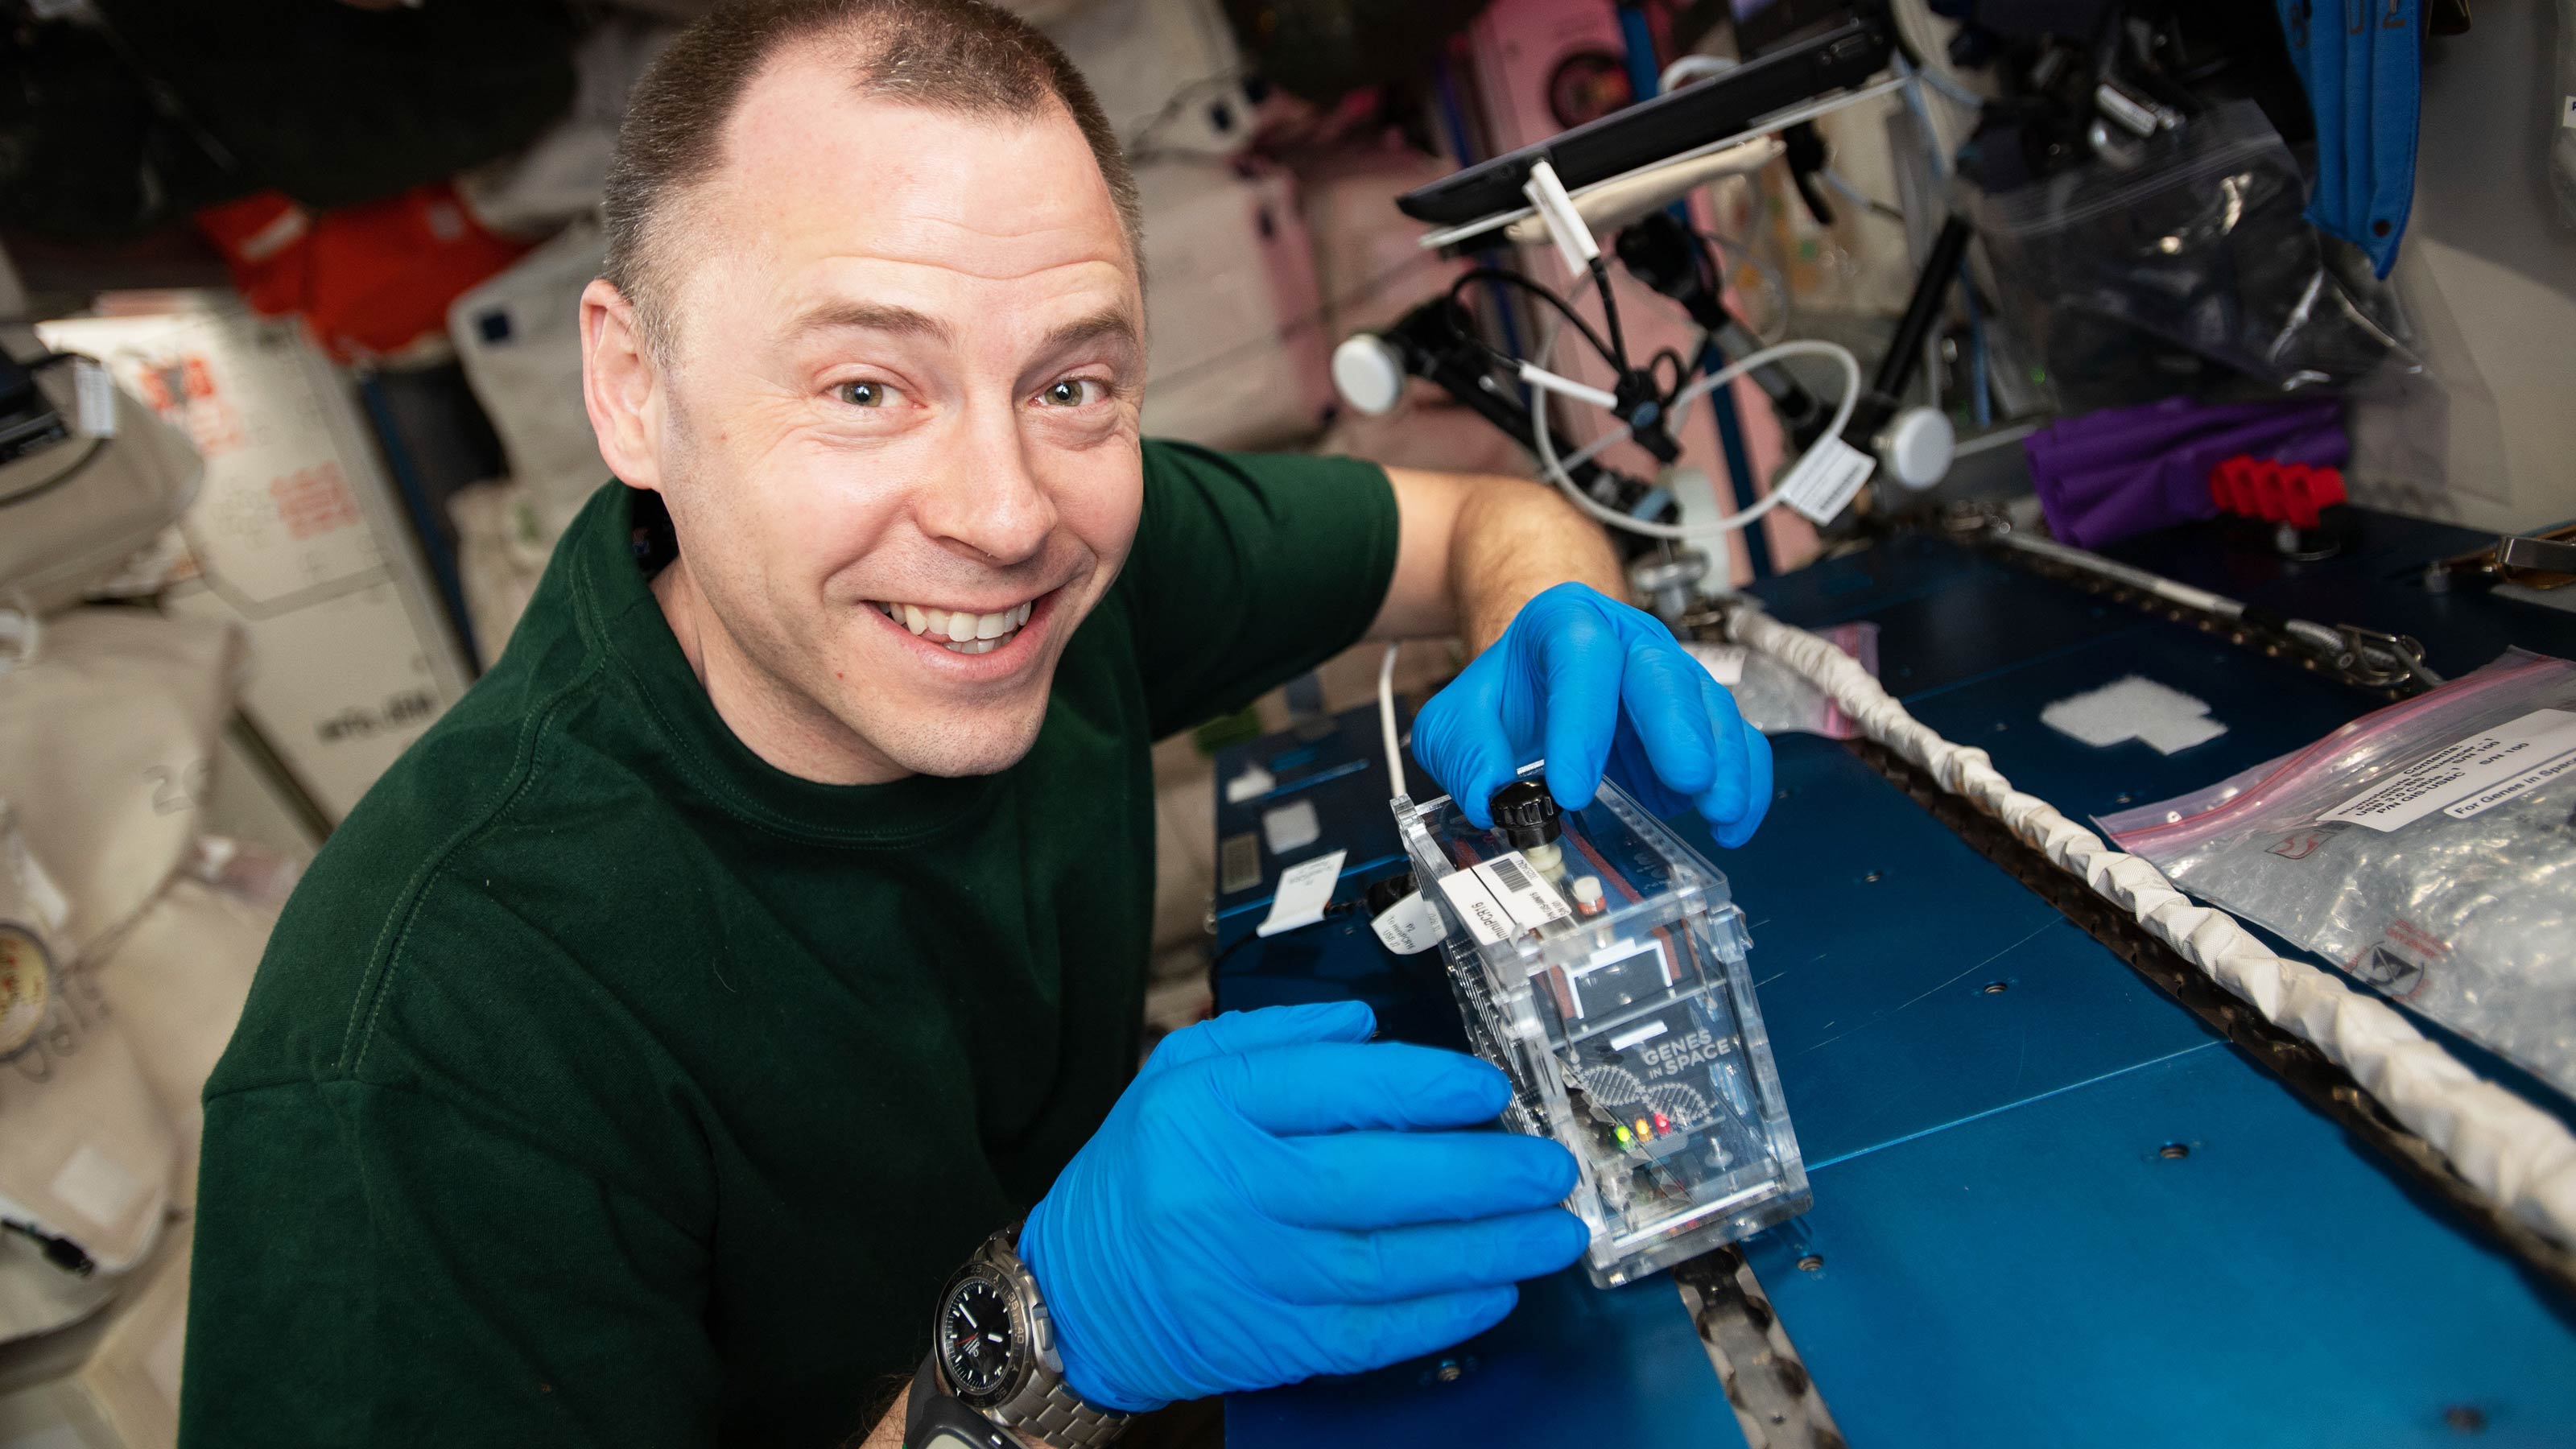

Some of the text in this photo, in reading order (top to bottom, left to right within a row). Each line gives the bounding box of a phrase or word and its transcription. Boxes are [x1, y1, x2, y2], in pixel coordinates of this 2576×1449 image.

[2404, 745, 2463, 774] Contents:
[2411, 746, 2475, 777] Sequencer
[2452, 753, 2477, 764] S/N
[2478, 741, 2500, 752] 100
[2355, 803, 2385, 816] USB
[2385, 792, 2406, 803] 3.0
[2406, 775, 2443, 792] Cable
[2376, 742, 2529, 814] P/N GIS-USBC S/N 100
[2455, 758, 2576, 815] For Genes in Spac
[1472, 902, 1509, 939] miniPCR16
[1644, 1030, 1712, 1066] GENES
[1648, 1038, 1732, 1080] IN SPACE
[1008, 1294, 1019, 1311] 35
[1017, 1327, 1024, 1344] 40
